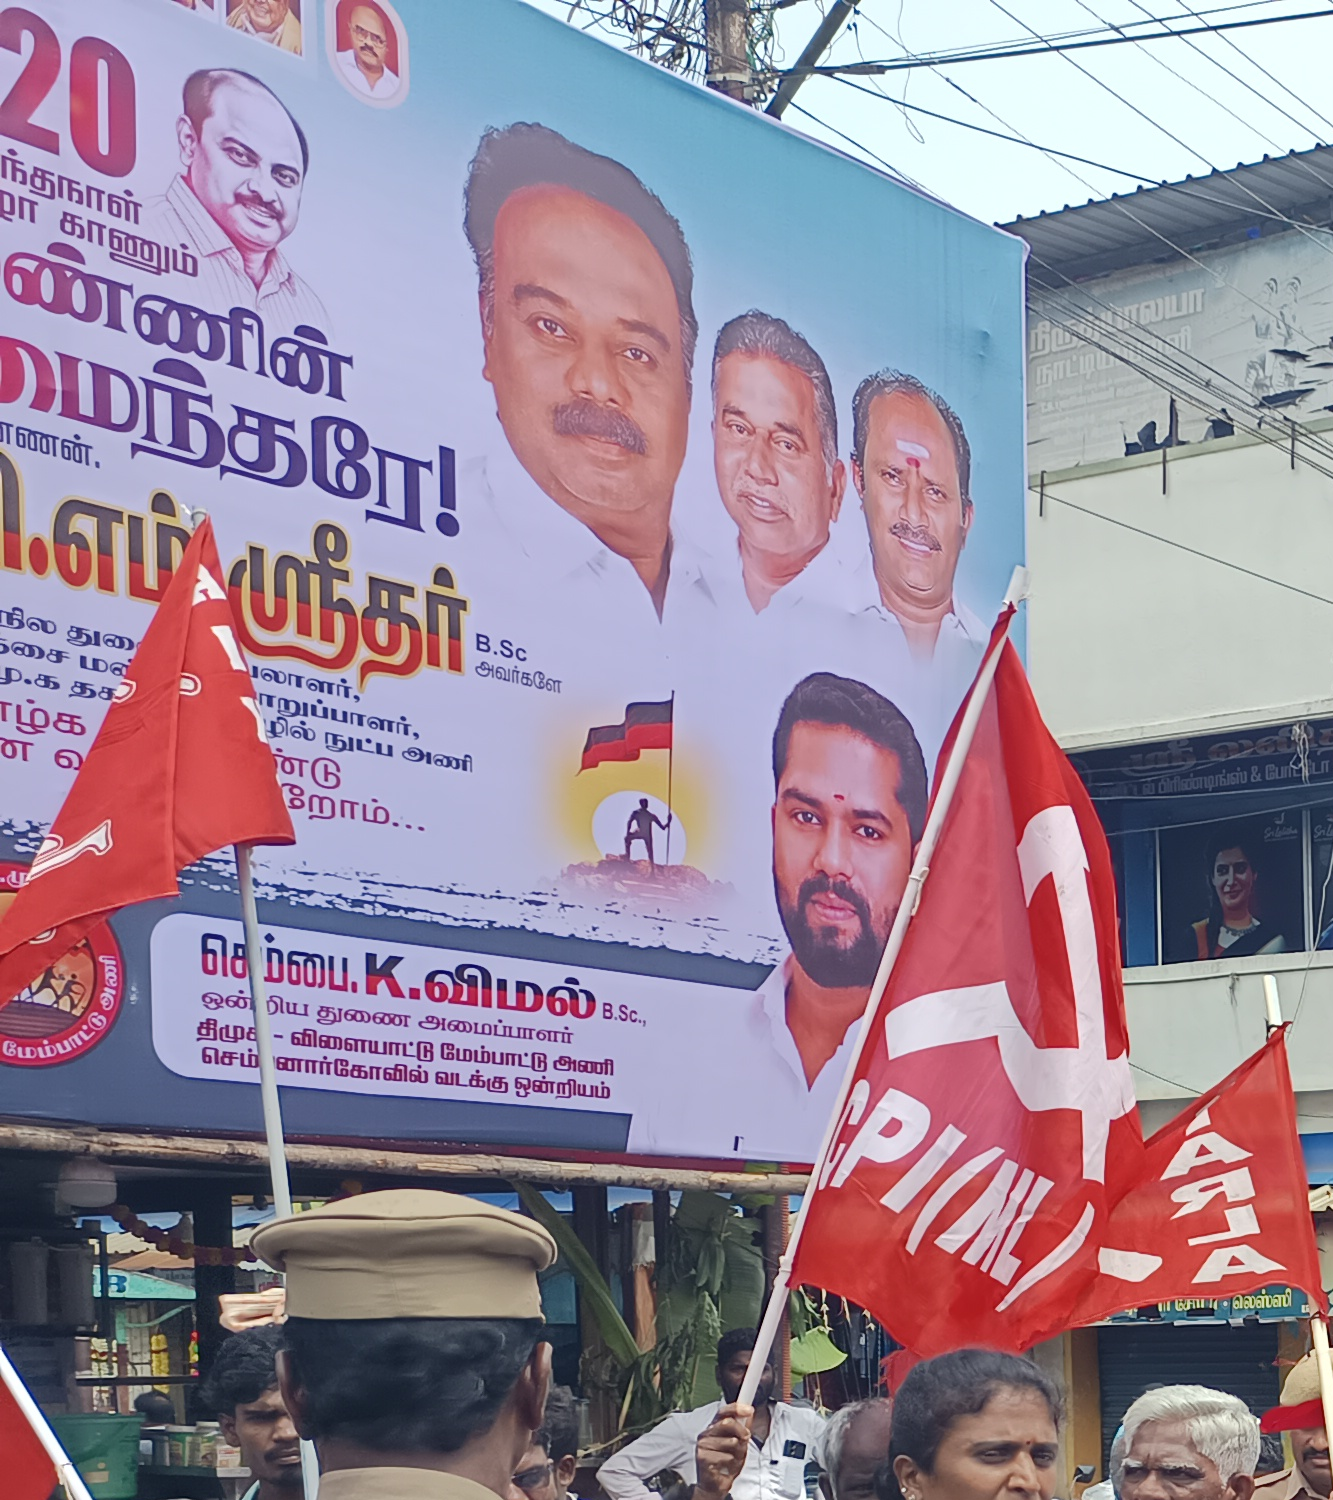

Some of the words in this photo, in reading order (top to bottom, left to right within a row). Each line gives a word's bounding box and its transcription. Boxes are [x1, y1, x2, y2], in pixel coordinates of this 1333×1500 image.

[0, 6, 136, 178] 20
[59, 212, 199, 277] காணும்
[474, 632, 527, 662] B.Sc
[474, 660, 563, 694] அவர்களே
[402, 746, 473, 773] அணி
[316, 1004, 412, 1029] துணை
[418, 1014, 574, 1044] அமைப்பாளர்
[290, 1028, 435, 1063] விளையாட்டு
[440, 1042, 548, 1073] மேம்பாட்டு
[553, 1055, 615, 1077] அணி
[435, 1070, 509, 1094] வடக்கு
[514, 1075, 611, 1100] ஒன்றியம்
